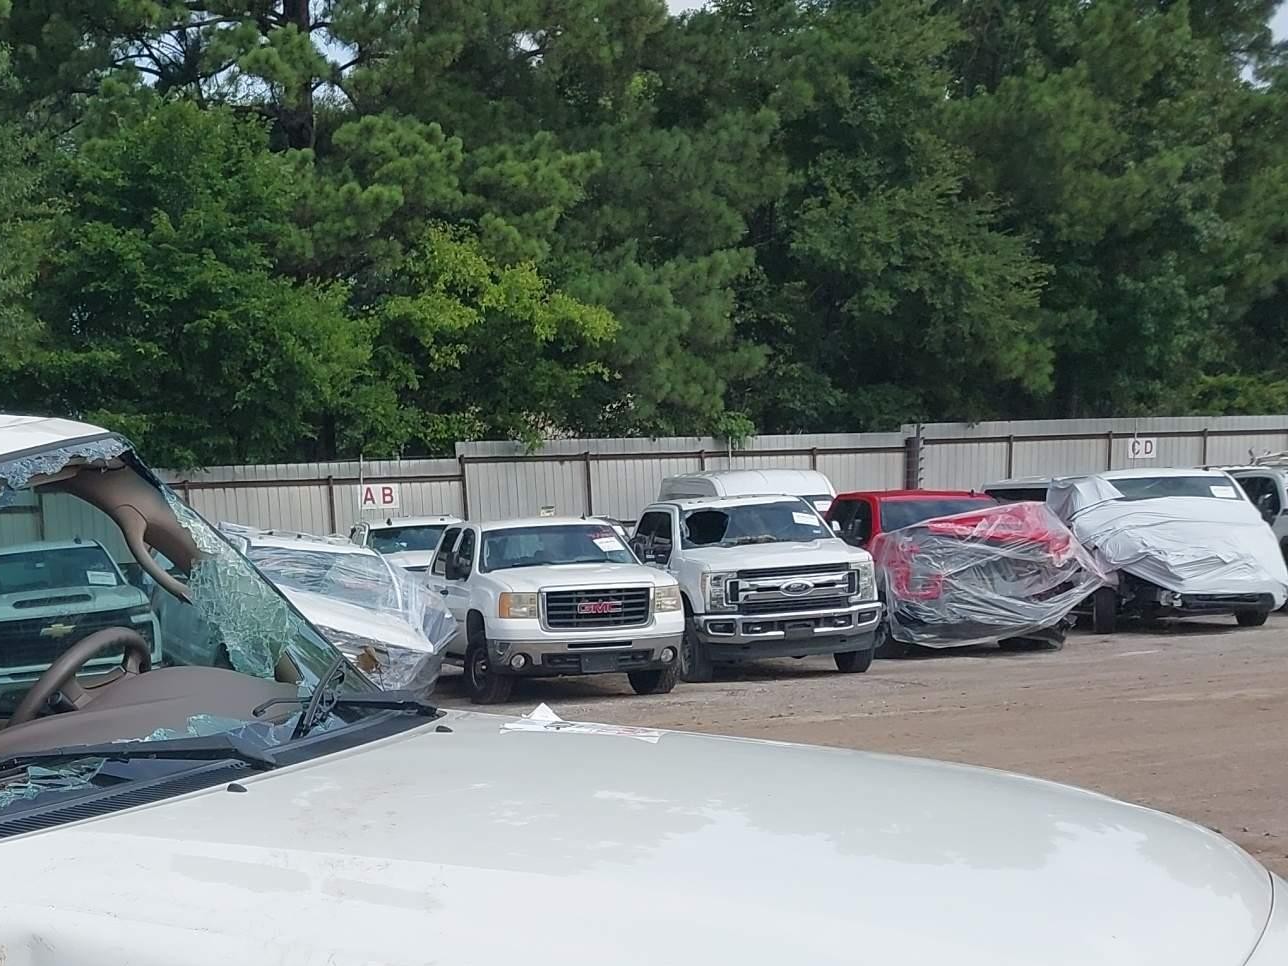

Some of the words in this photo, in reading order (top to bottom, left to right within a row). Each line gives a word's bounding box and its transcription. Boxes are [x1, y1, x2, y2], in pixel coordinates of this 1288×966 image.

[1132, 440, 1140, 455] C
[1145, 440, 1153, 455] D
[363, 487, 376, 504] A
[382, 486, 394, 504] B
[578, 601, 622, 613] GMC
